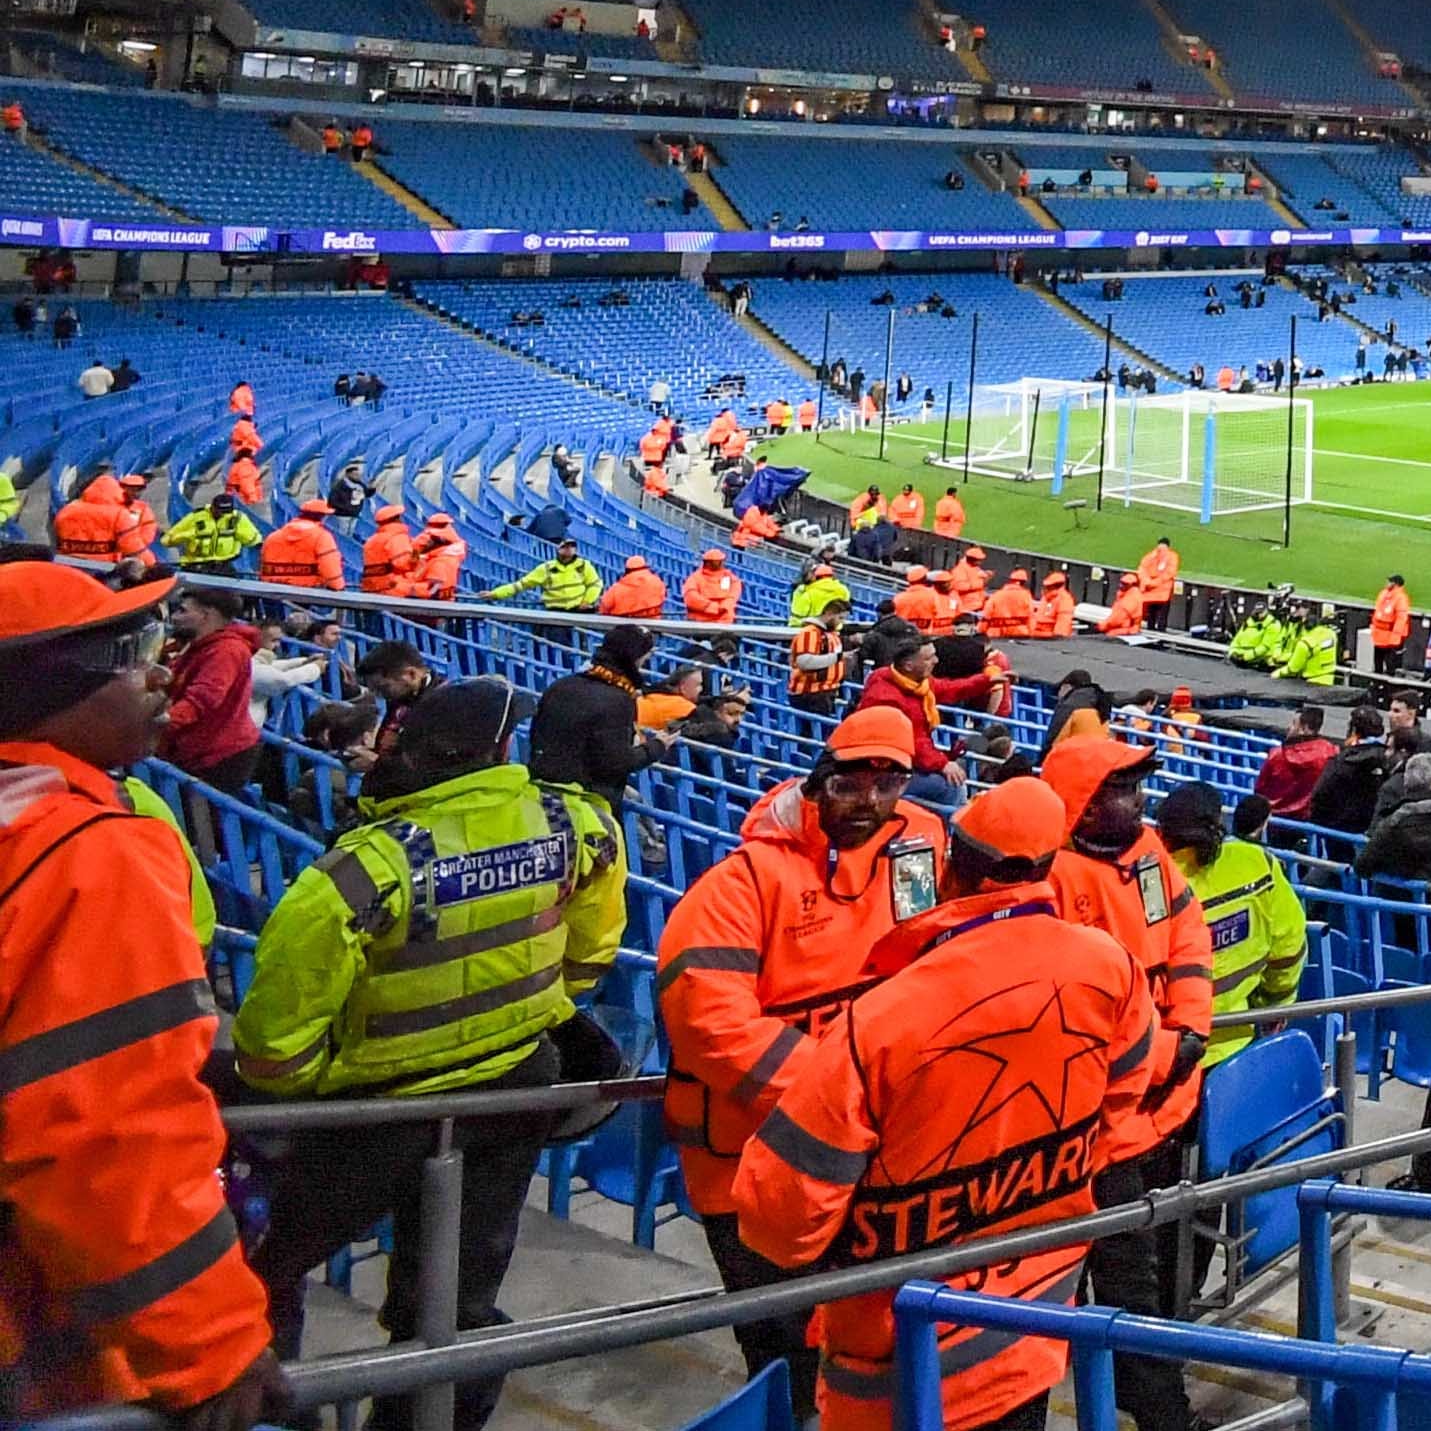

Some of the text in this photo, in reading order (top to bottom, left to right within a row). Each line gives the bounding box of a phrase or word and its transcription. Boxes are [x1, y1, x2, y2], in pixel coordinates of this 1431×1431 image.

[170, 231, 210, 245] LEAGUE
[322, 231, 375, 250] FedEx
[544, 235, 630, 249] crypto.com
[770, 235, 825, 248] bet365
[929, 234, 1055, 245] UEFA CHAMPIONS LEAGUE
[439, 853, 492, 878] GREATER
[460, 857, 546, 895] POLICE
